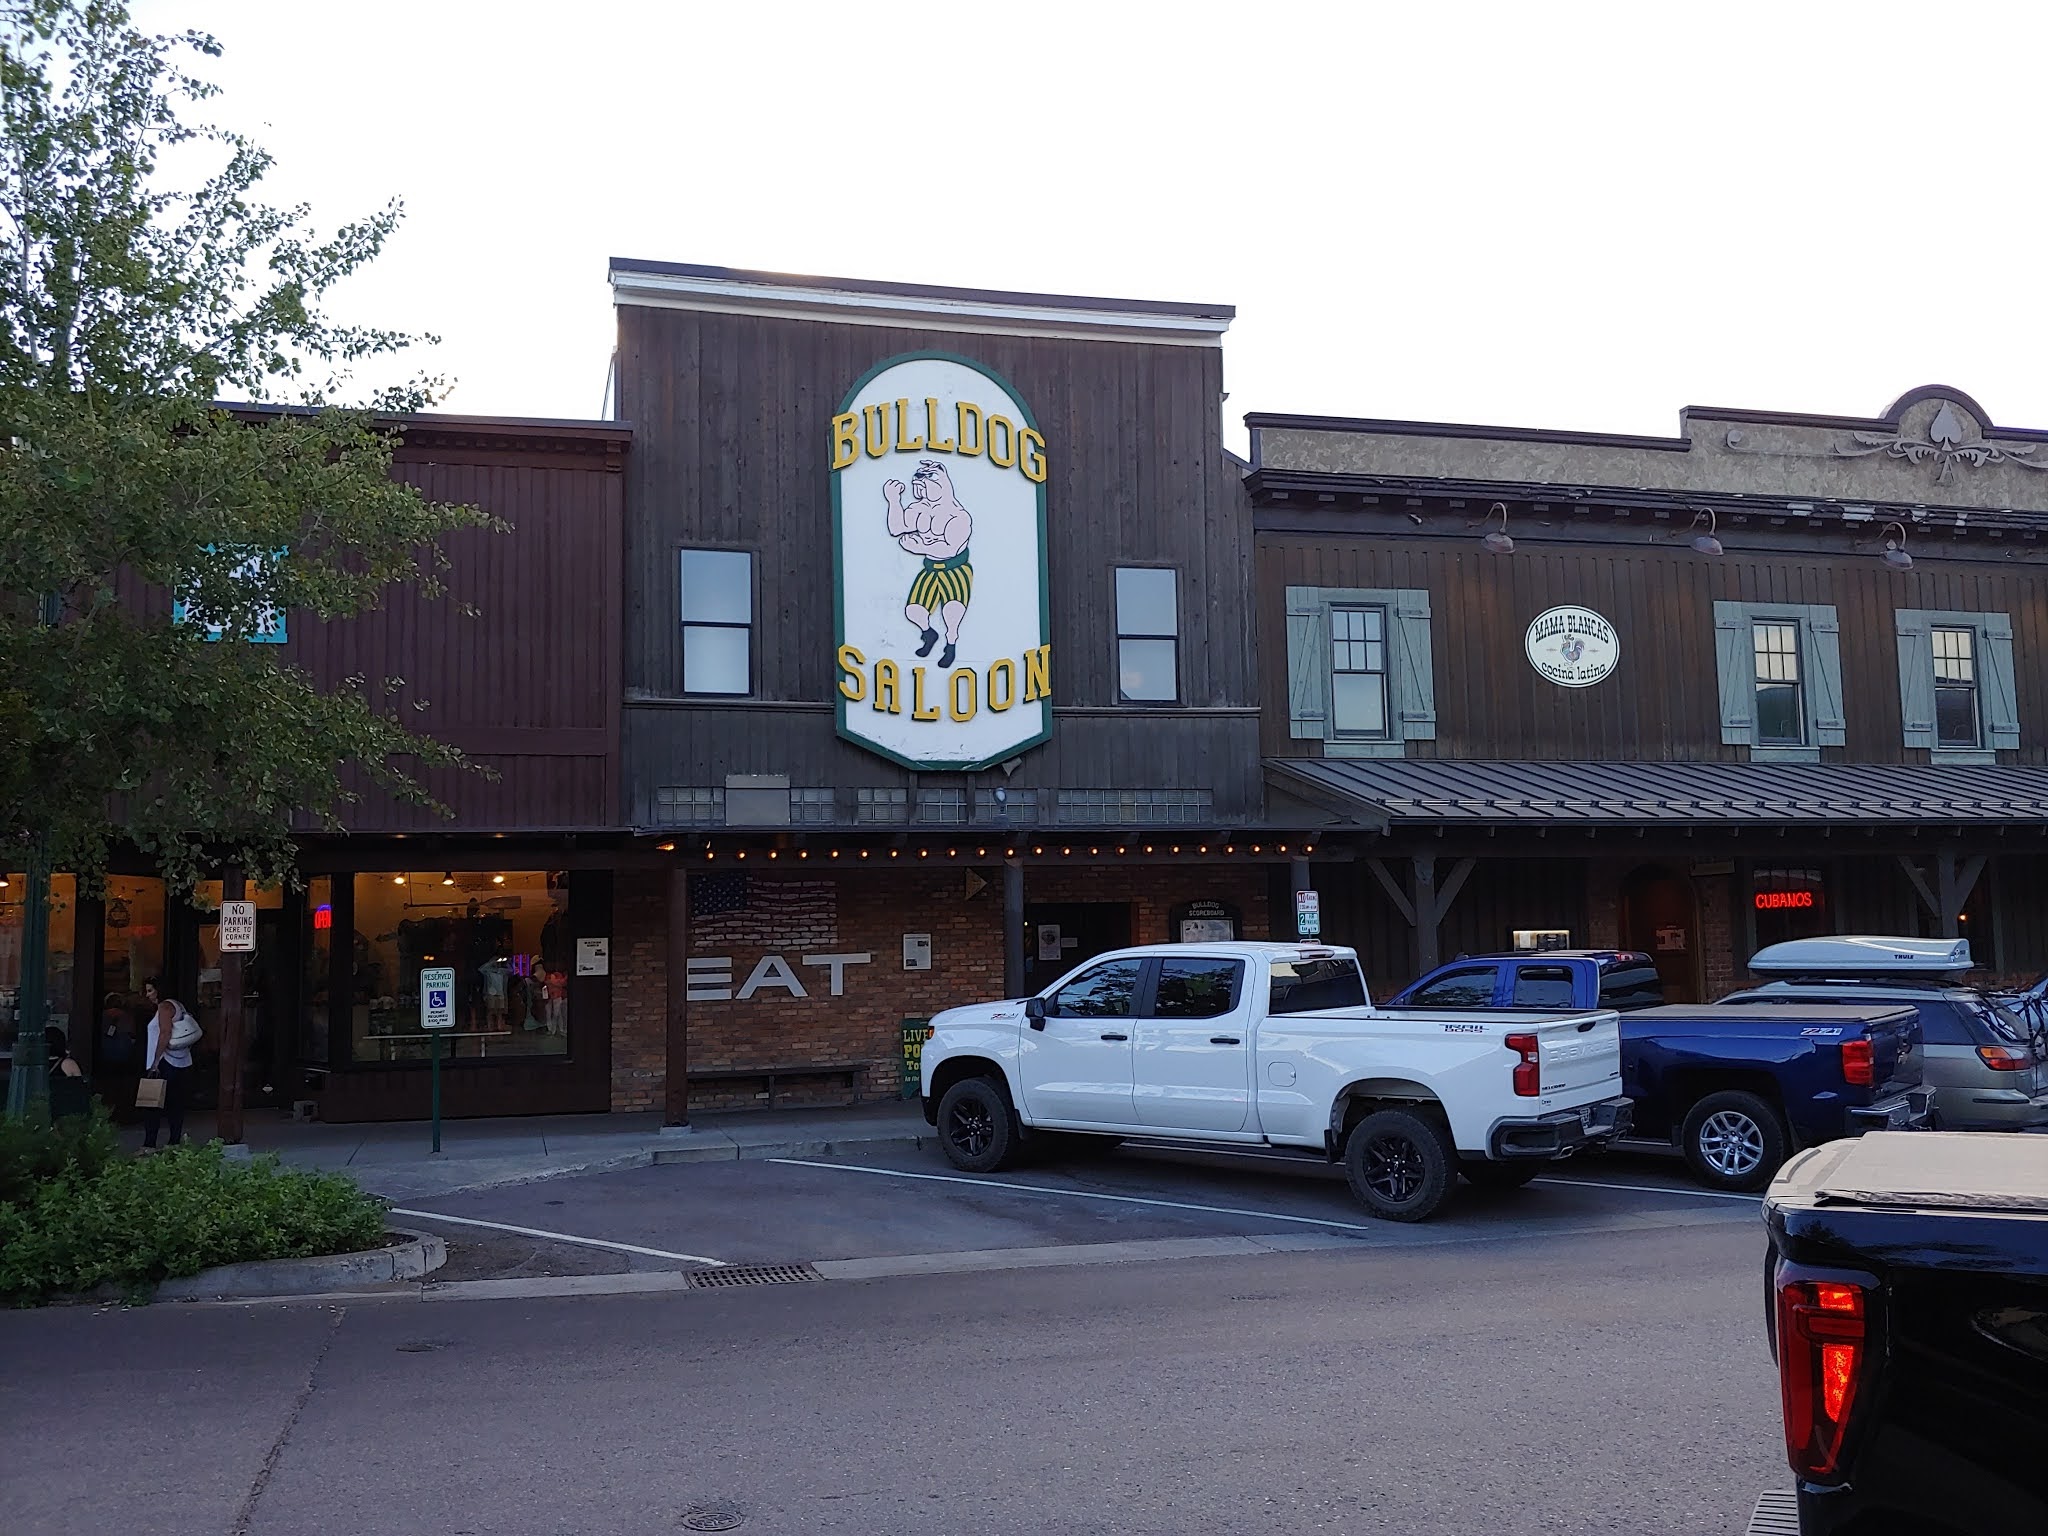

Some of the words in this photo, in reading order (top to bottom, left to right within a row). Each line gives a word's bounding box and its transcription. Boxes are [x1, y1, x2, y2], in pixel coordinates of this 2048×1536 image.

[831, 397, 1048, 483] BULLDOG
[1535, 615, 1565, 643] MAMA
[1567, 615, 1609, 644] BLANCAS
[1541, 662, 1574, 680] cocina
[1577, 664, 1606, 680] latina
[837, 643, 1053, 722] SALOON
[1191, 901, 1220, 909] BULLDOG
[1755, 892, 1813, 909] CUBANOS
[231, 904, 245, 915] NO
[223, 917, 253, 926] PARKING
[1300, 914, 1305, 925] 2
[424, 973, 452, 981] RESERVED
[686, 952, 872, 1002] EAT
[903, 1044, 923, 1058] PO
